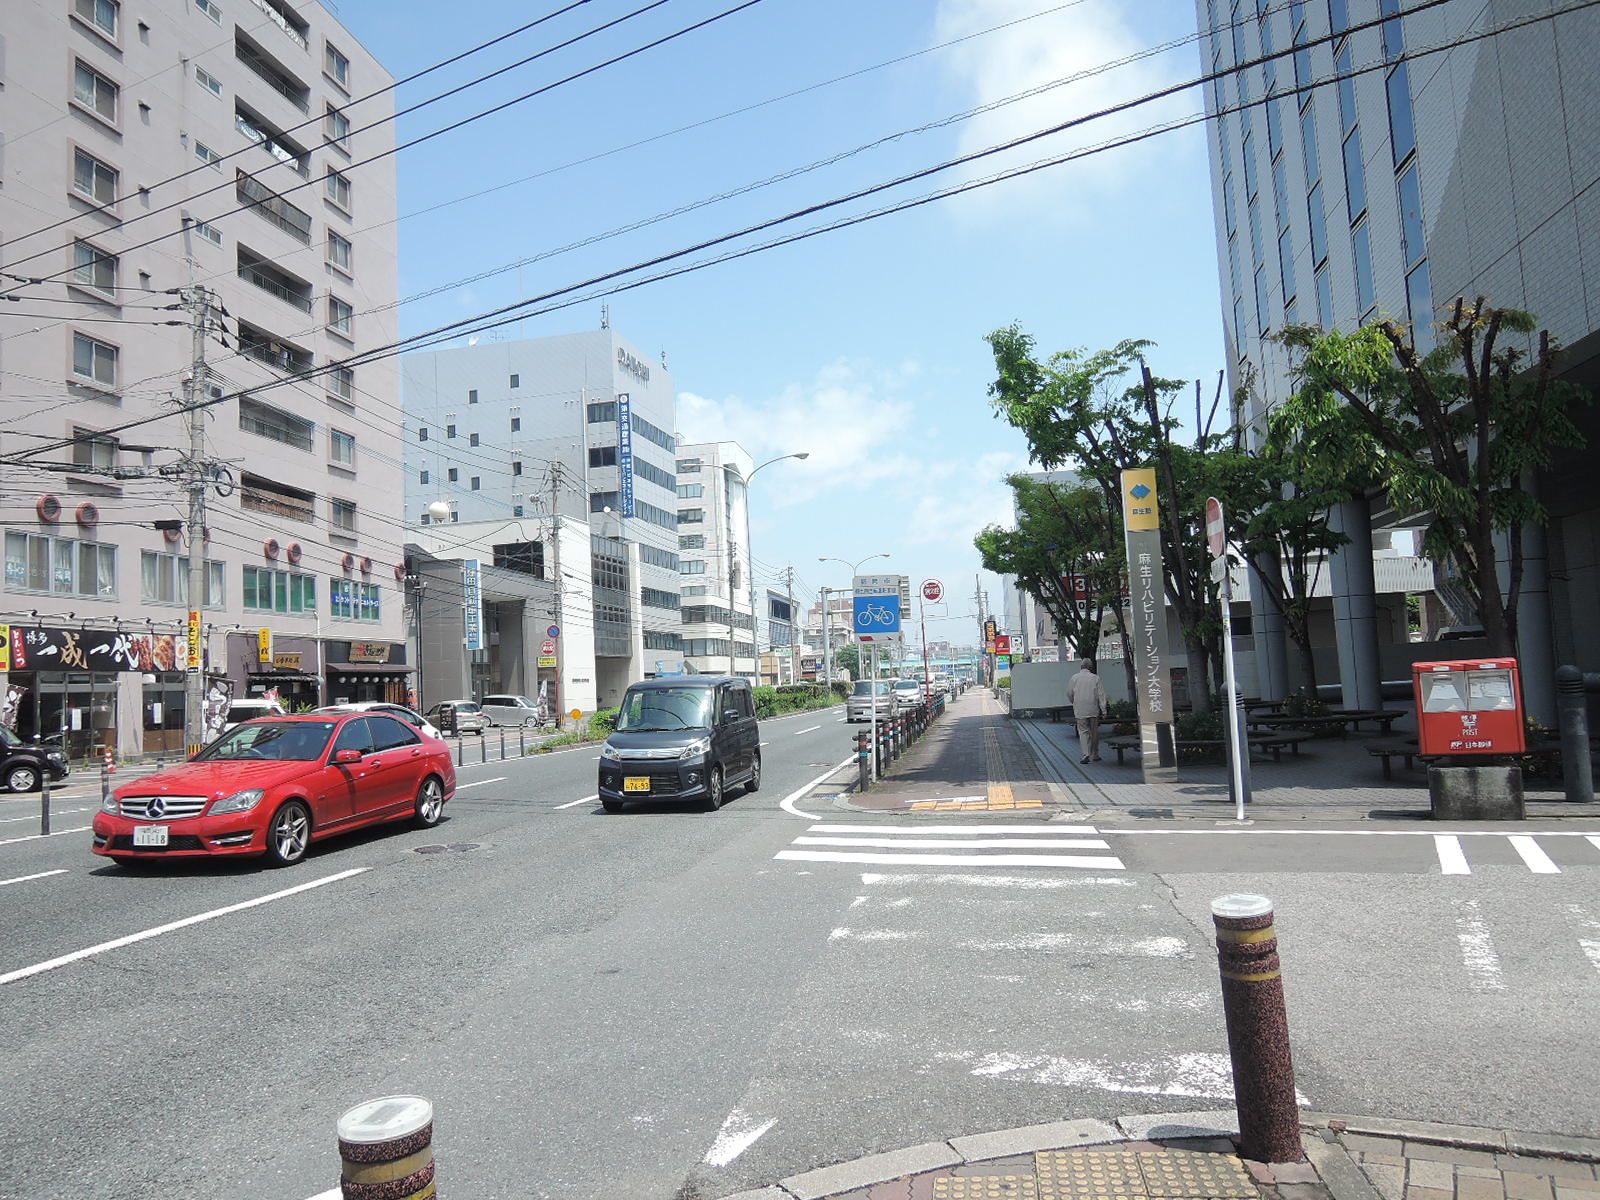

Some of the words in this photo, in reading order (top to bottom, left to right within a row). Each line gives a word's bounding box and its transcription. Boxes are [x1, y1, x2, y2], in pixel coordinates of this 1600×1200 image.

[12, 629, 25, 666] とんこつ
[25, 630, 48, 646] 博多
[36, 631, 139, 670] 一成一代
[1138, 552, 1163, 713] 麻生リハビリテーション大学校
